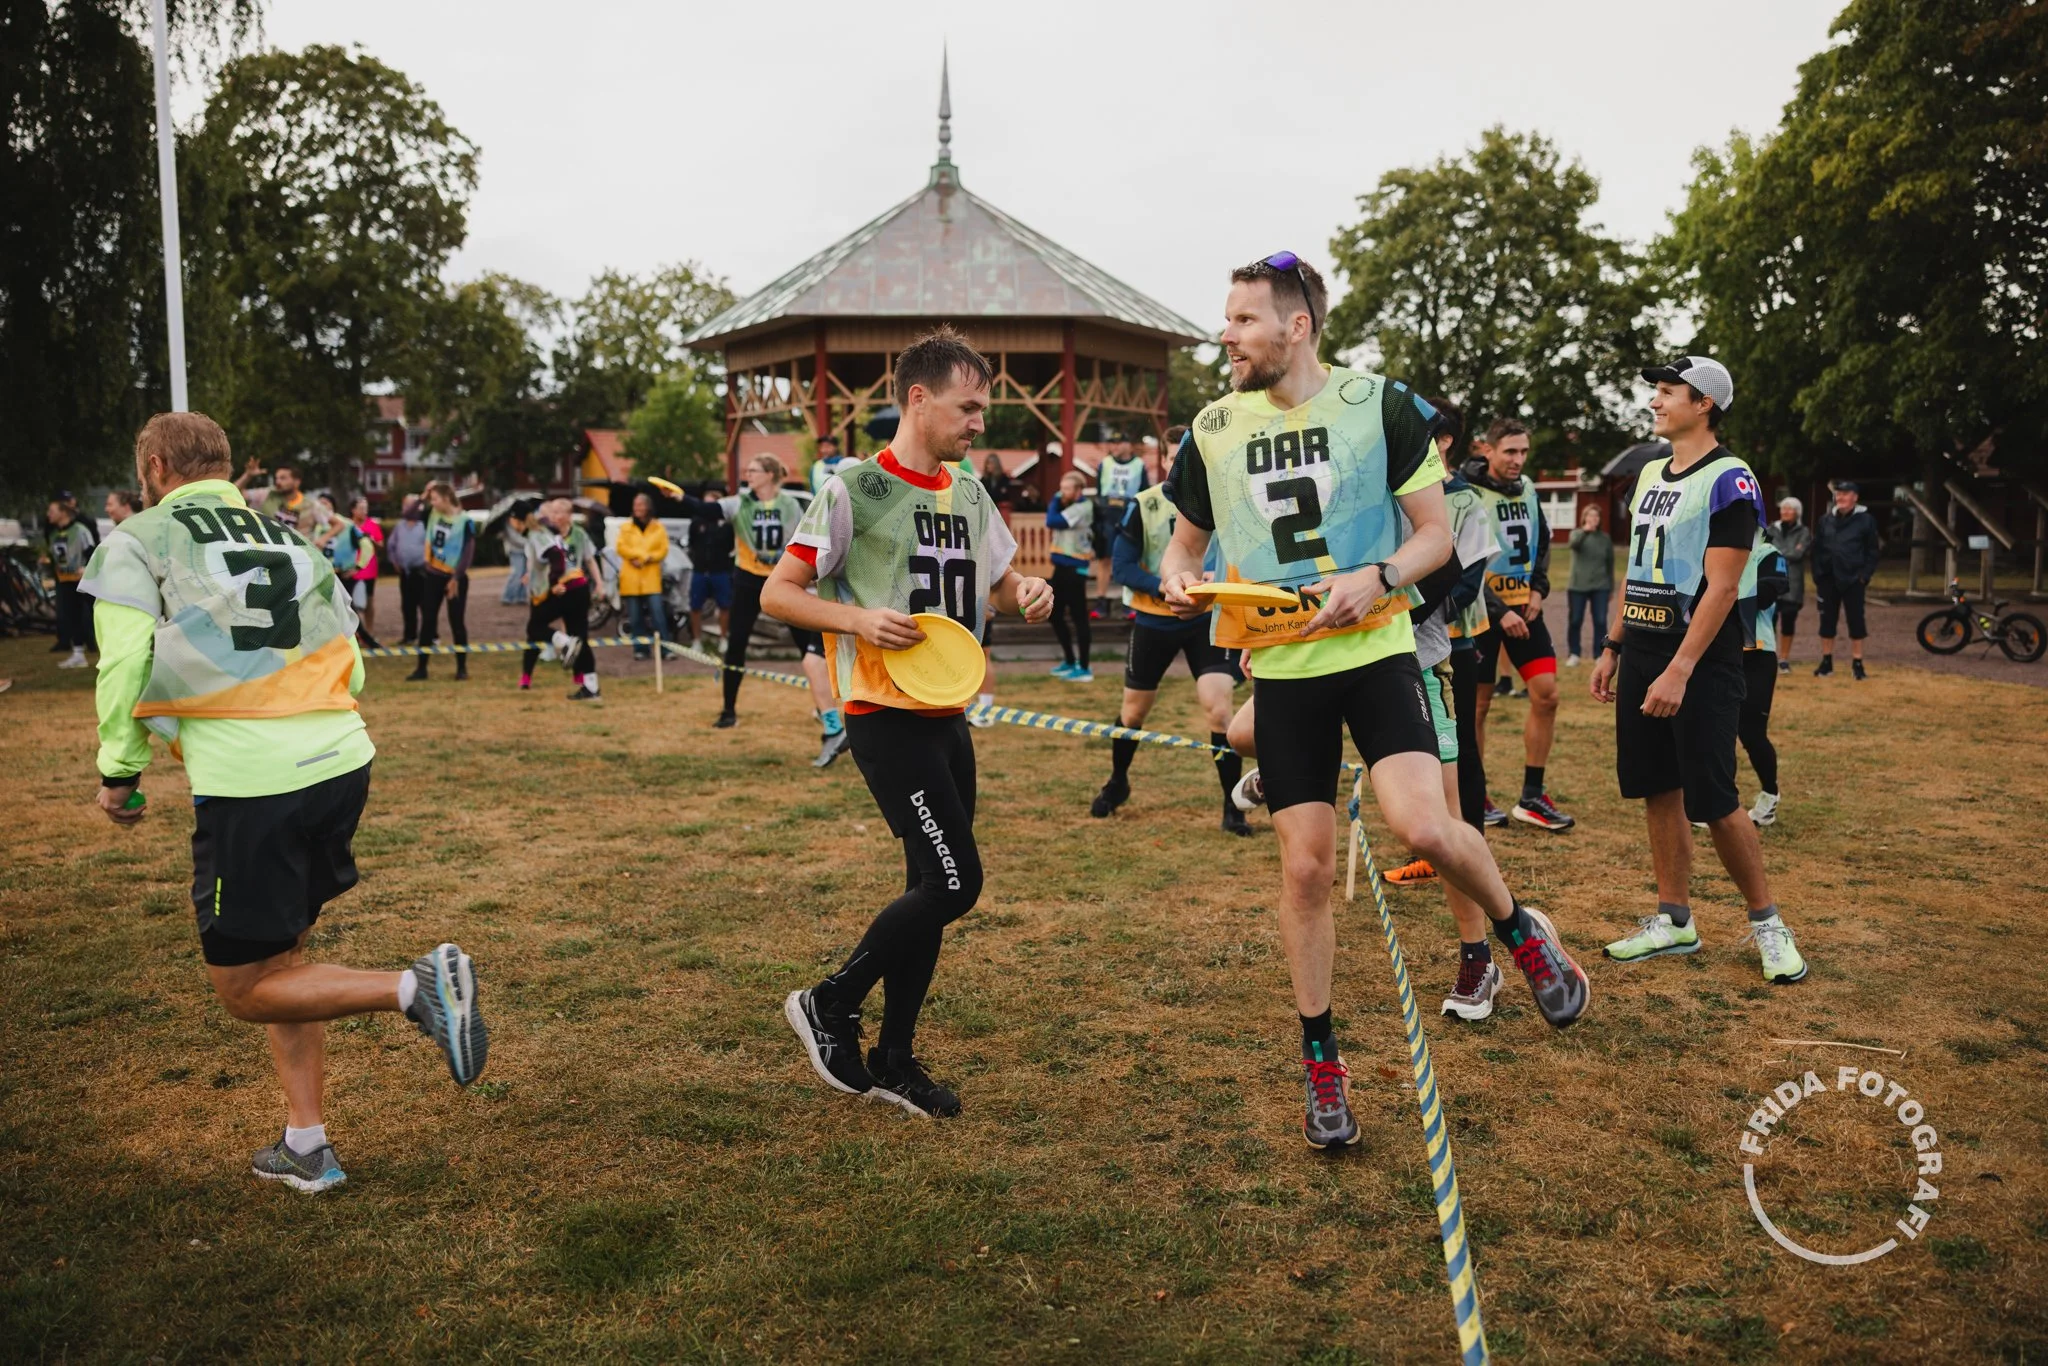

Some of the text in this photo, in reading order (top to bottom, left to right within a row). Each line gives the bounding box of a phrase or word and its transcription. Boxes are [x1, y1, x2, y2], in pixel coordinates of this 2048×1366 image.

[1247, 427, 1330, 475] ÖAR
[1266, 476, 1330, 565] 2
[1496, 500, 1530, 522] ÖAR
[1638, 485, 1682, 517] ÖAR
[172, 502, 307, 545] ÖAR
[751, 525, 784, 551] 10
[914, 504, 971, 551] ÖAR
[1506, 524, 1531, 566] 3
[1634, 524, 1666, 570] 11
[222, 550, 302, 652] 3
[908, 555, 977, 632] 20
[1623, 604, 1666, 623] JOKAB
[1262, 622, 1286, 634] John
[1416, 687, 1430, 722] CRAFT
[909, 789, 961, 891] bagheera
